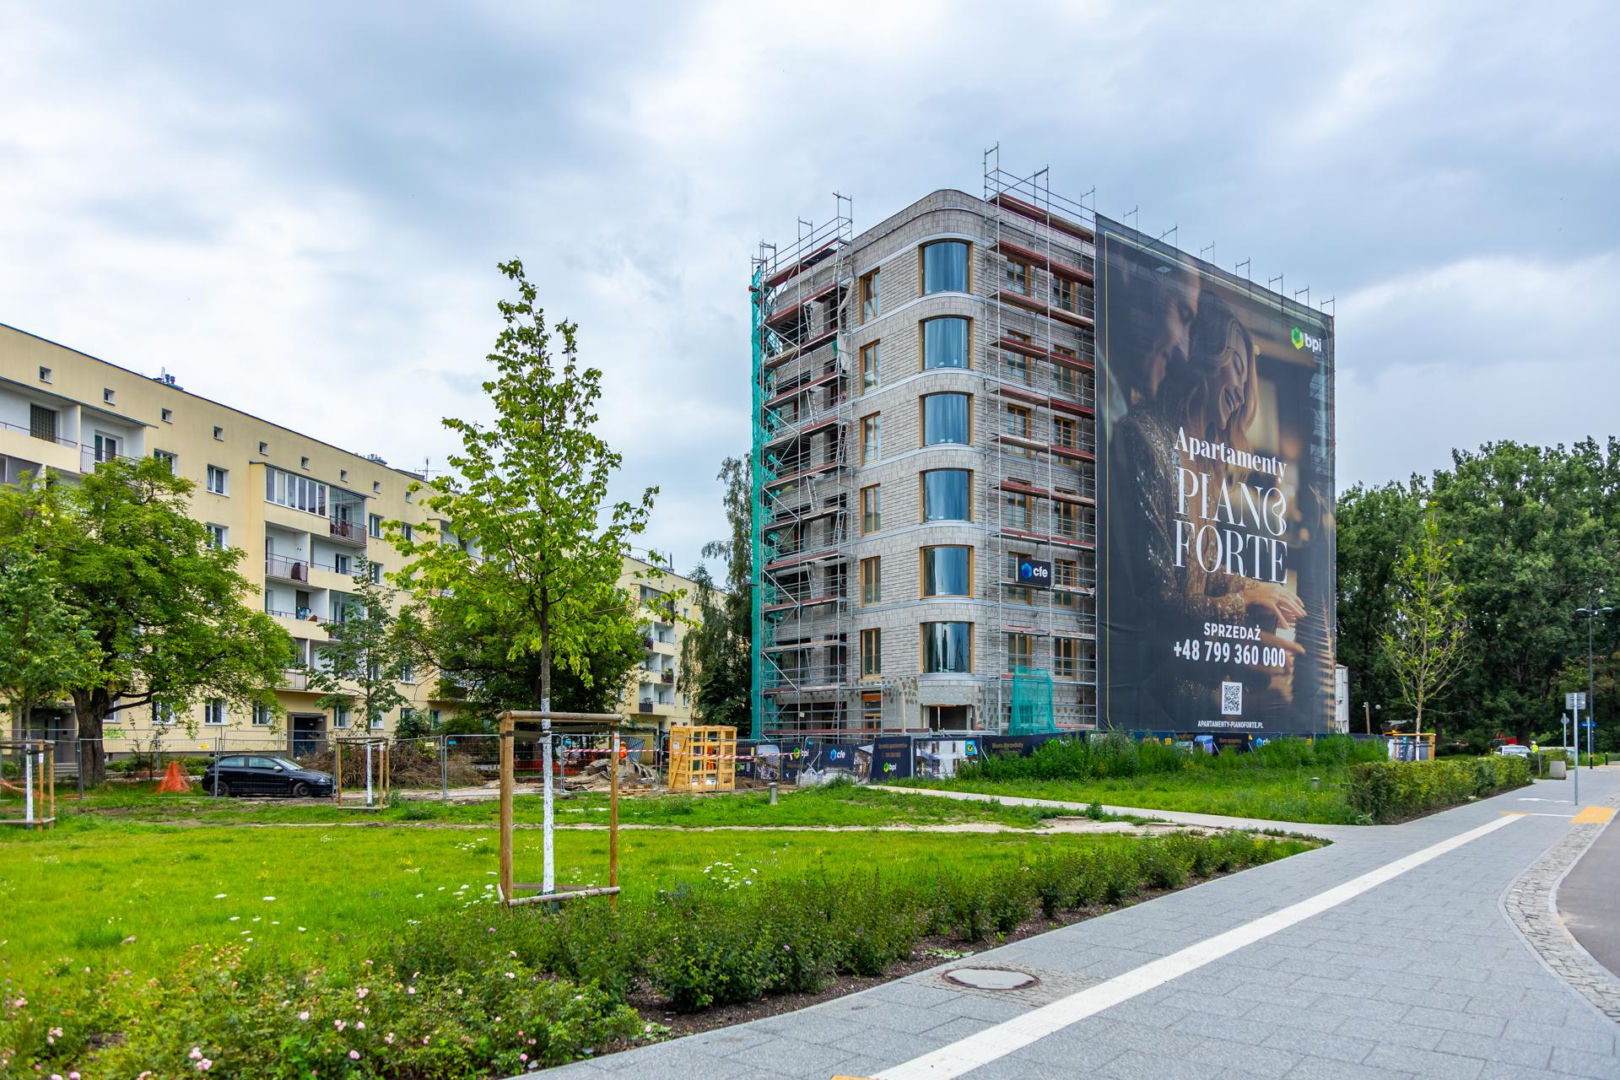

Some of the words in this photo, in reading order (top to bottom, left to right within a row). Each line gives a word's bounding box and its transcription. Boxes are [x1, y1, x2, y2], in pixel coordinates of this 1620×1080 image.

[1304, 333, 1322, 352] bpi
[1174, 426, 1287, 483] Apartamenty
[1175, 466, 1287, 536] PIANO
[1173, 519, 1288, 584] FORTE
[1032, 566, 1048, 578] cfe
[1203, 622, 1261, 641] SPRZEDAŻ
[1173, 639, 1200, 661] +48
[1204, 641, 1230, 663] 799
[1234, 644, 1259, 666] 360
[1262, 646, 1286, 667] 000
[1197, 720, 1264, 729] APARTAMENTY-PIANOFORTE.PL
